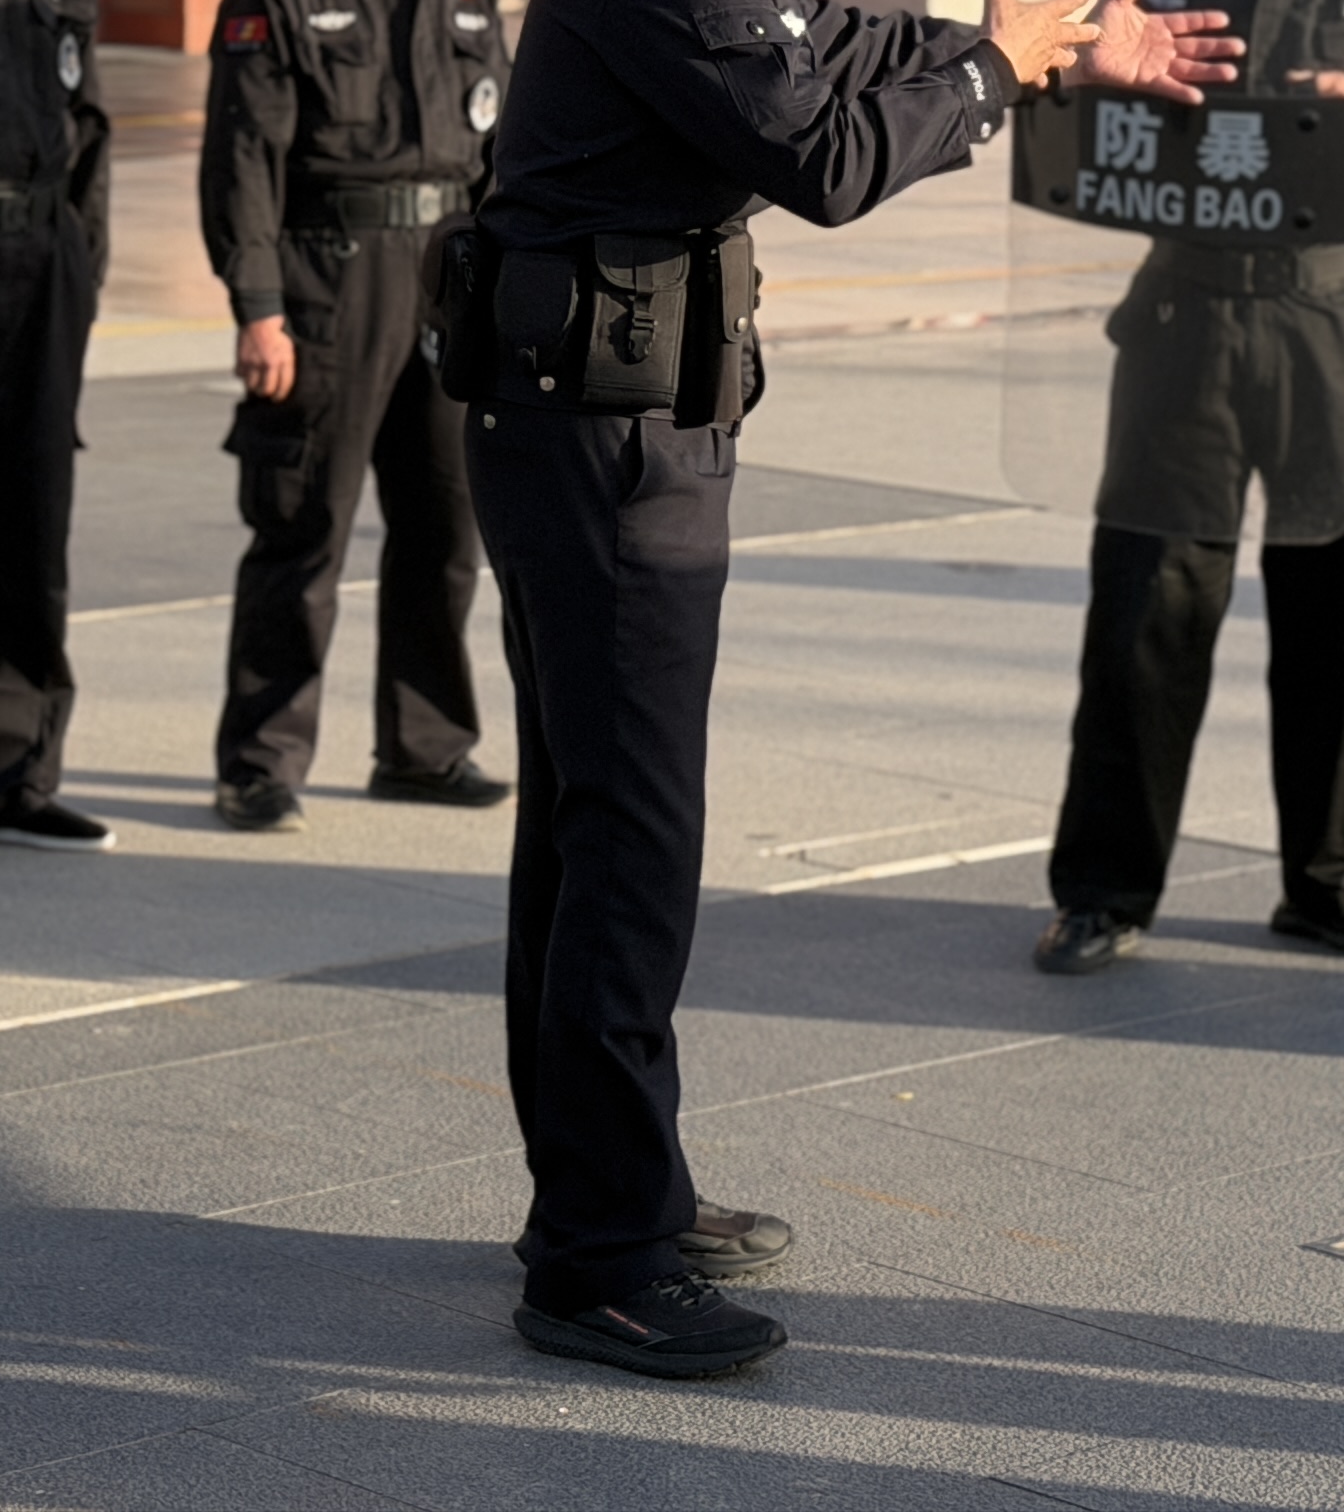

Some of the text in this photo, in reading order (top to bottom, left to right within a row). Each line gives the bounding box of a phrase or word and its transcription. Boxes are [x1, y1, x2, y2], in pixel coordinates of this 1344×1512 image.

[963, 60, 986, 101] POLICE
[1076, 168, 1283, 231] FANG BAO
